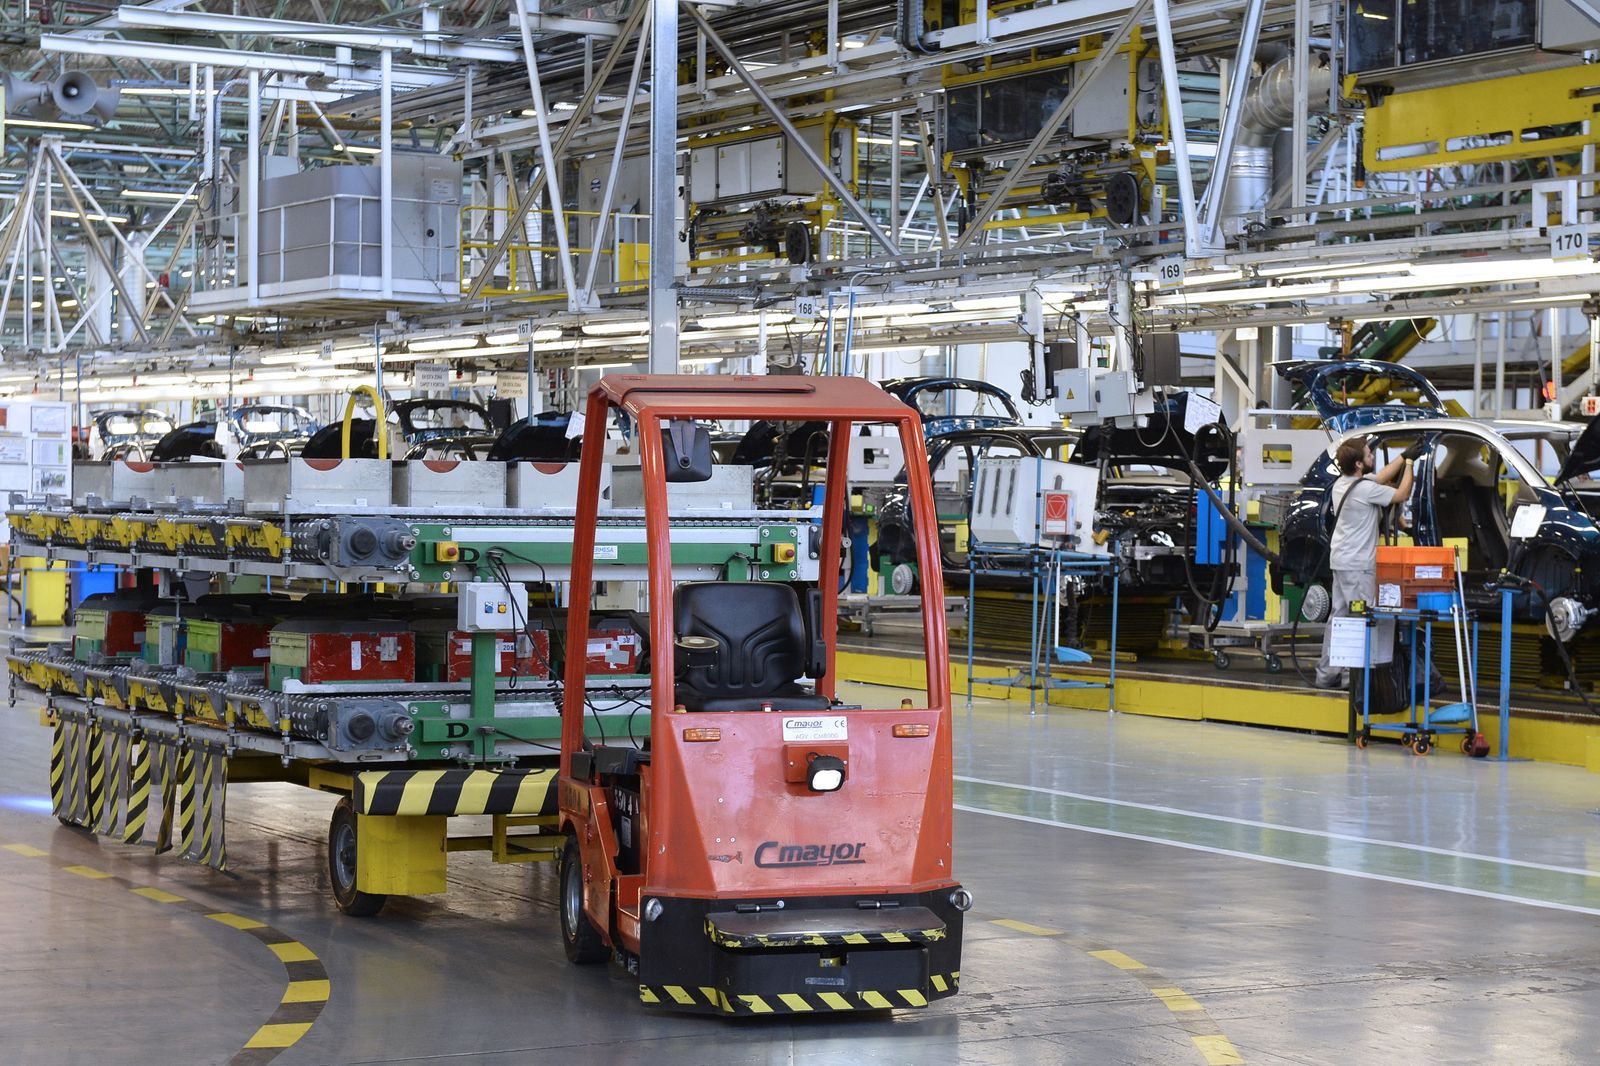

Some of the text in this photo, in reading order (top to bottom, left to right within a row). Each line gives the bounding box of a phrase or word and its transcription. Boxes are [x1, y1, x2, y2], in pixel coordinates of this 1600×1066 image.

[1555, 232, 1583, 251] 170
[1160, 264, 1180, 279] 169
[798, 302, 813, 315] 168
[518, 323, 529, 334] 167
[459, 546, 480, 563] D
[446, 722, 470, 738] D
[785, 719, 824, 729] Cmayor
[754, 841, 866, 868] Cmayor
